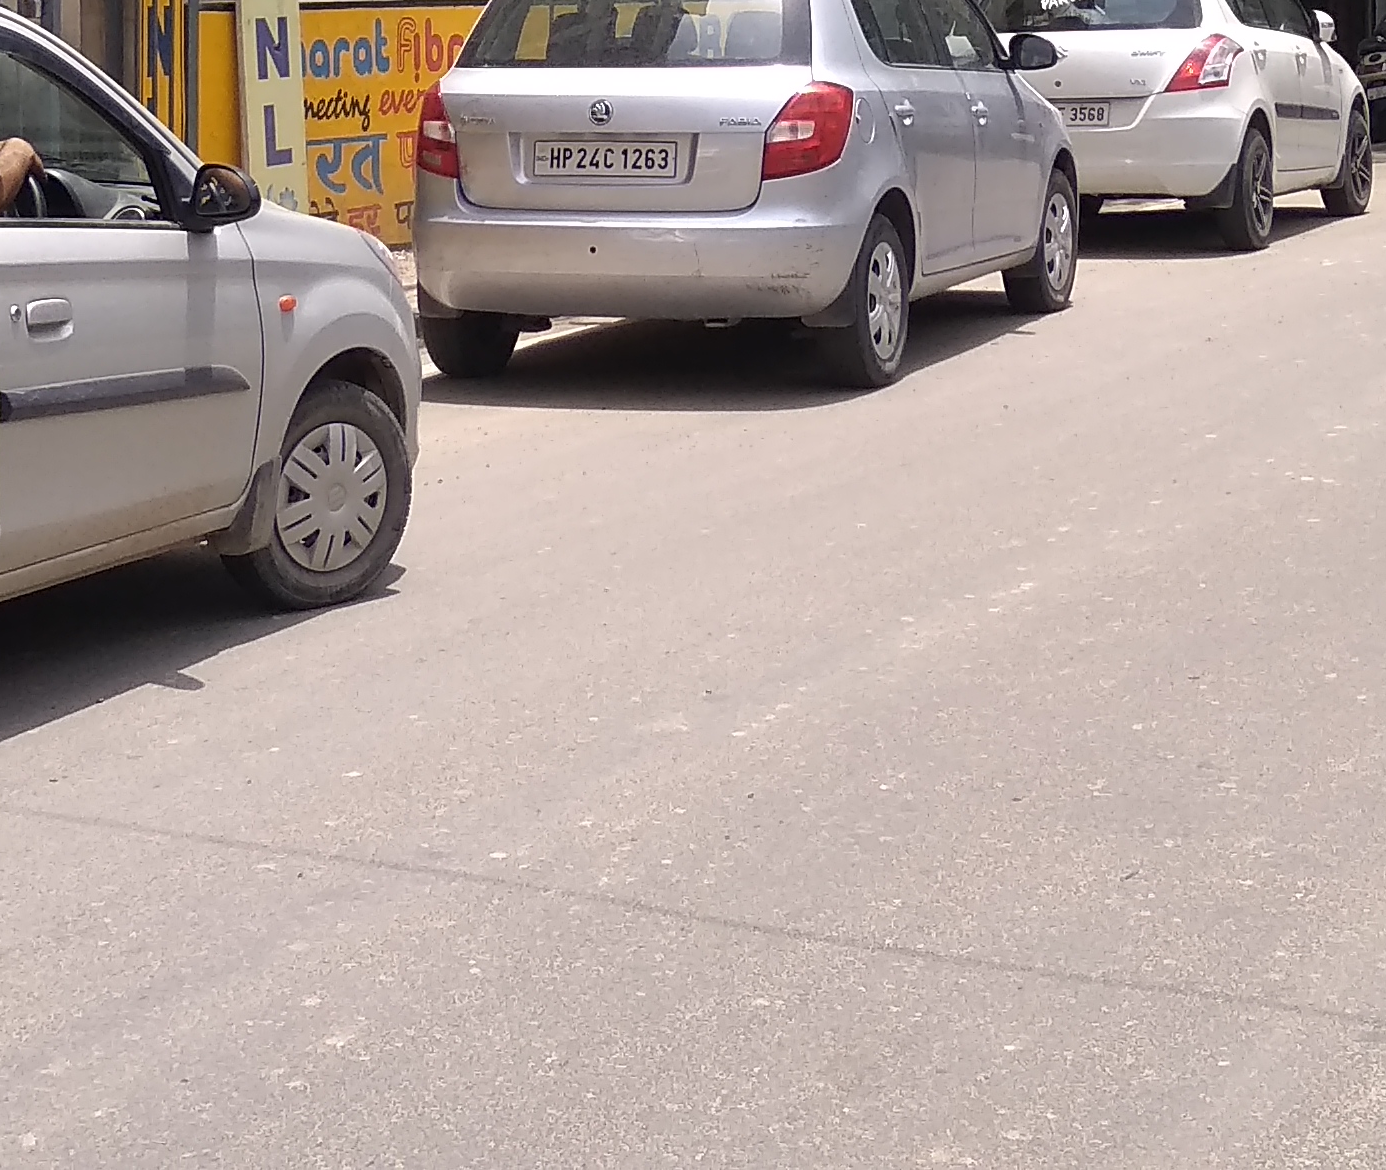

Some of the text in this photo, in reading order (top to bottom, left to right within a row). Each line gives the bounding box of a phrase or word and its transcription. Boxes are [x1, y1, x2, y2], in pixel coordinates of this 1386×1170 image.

[1069, 107, 1105, 123] 3568
[549, 147, 670, 170] HP 24C 1263
